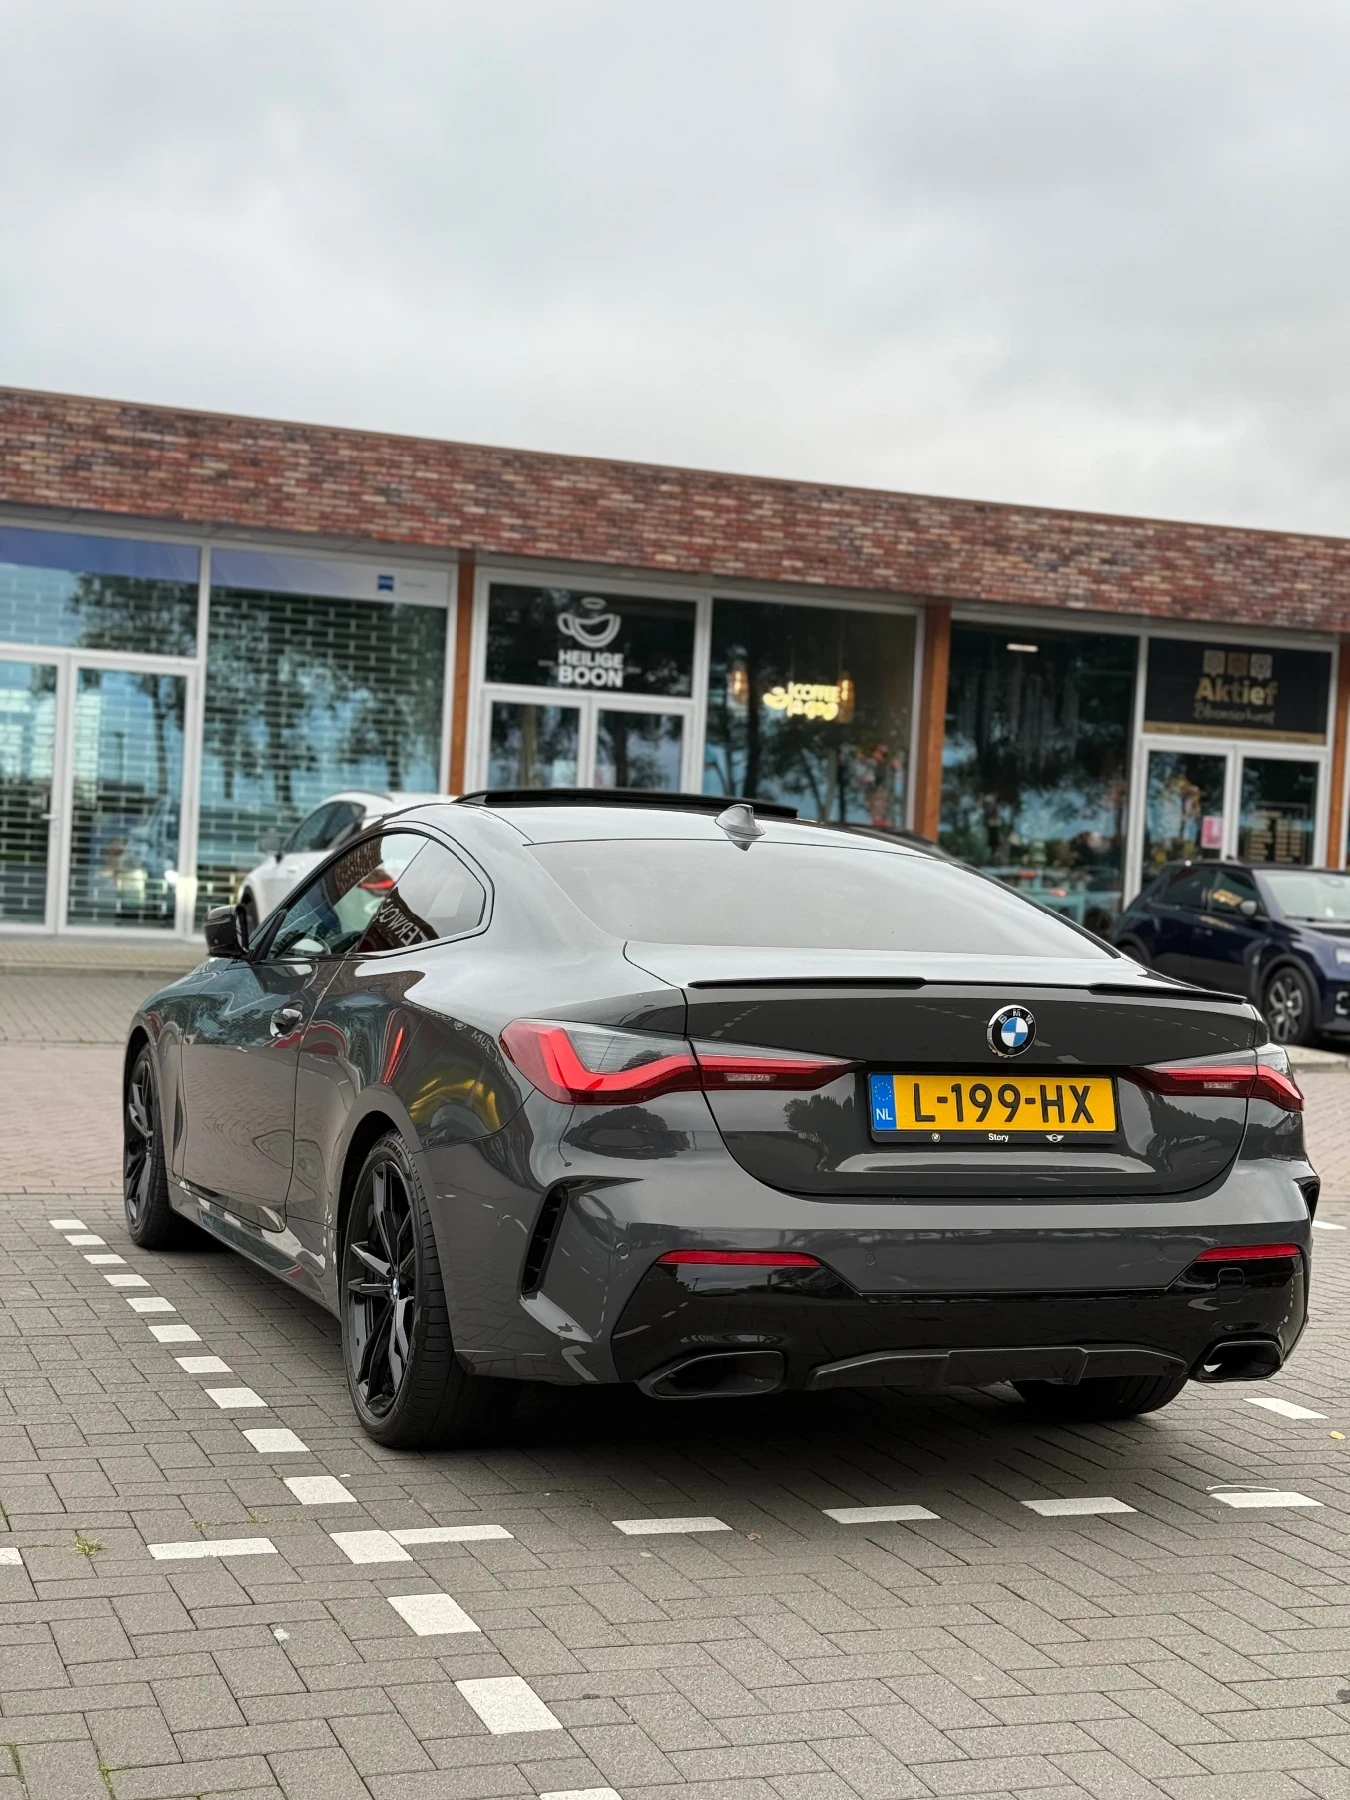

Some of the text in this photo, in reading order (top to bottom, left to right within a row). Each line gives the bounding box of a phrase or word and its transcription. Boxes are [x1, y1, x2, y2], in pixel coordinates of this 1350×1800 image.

[558, 649, 624, 669] HEILIGE
[558, 666, 623, 688] BOON
[1195, 677, 1278, 706] Aktief
[913, 1082, 1095, 1124] L-199-HX
[875, 1108, 893, 1121] NL
[988, 1132, 1009, 1143] Story
